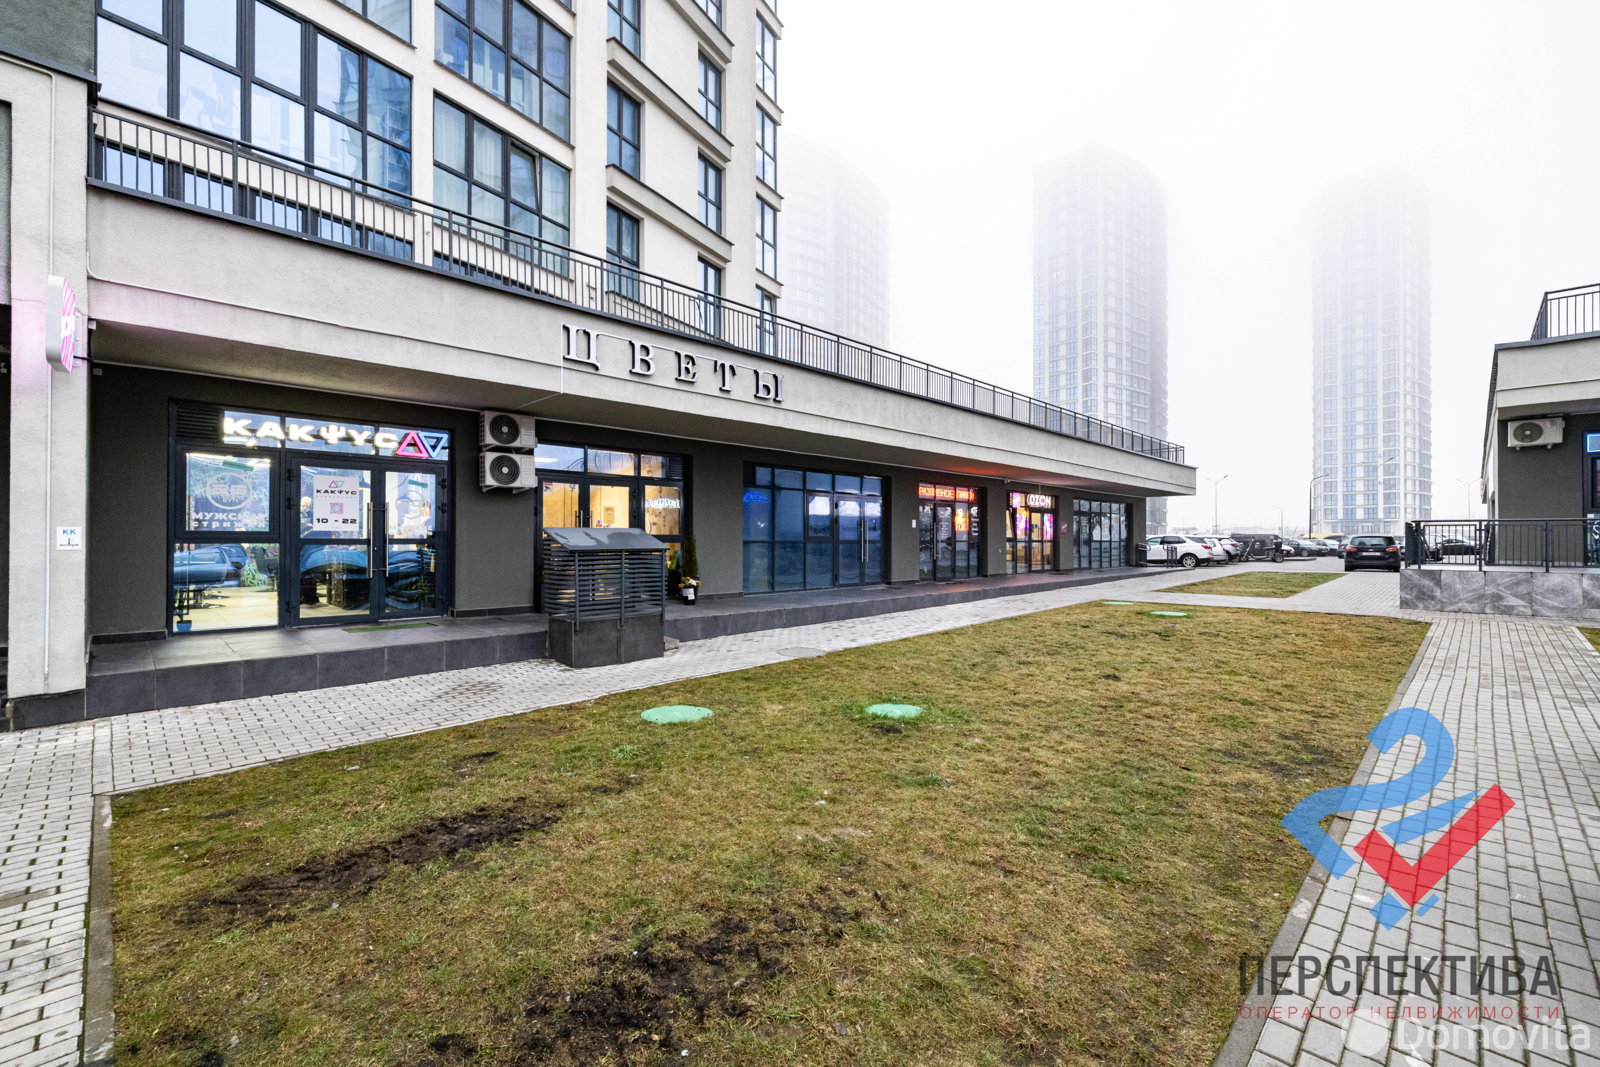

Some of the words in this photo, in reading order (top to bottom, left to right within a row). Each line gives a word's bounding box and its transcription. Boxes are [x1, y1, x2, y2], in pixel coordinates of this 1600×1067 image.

[562, 324, 784, 402] ЦВЕТЫ
[222, 495, 239, 503] BYN
[1028, 493, 1052, 507] OZON
